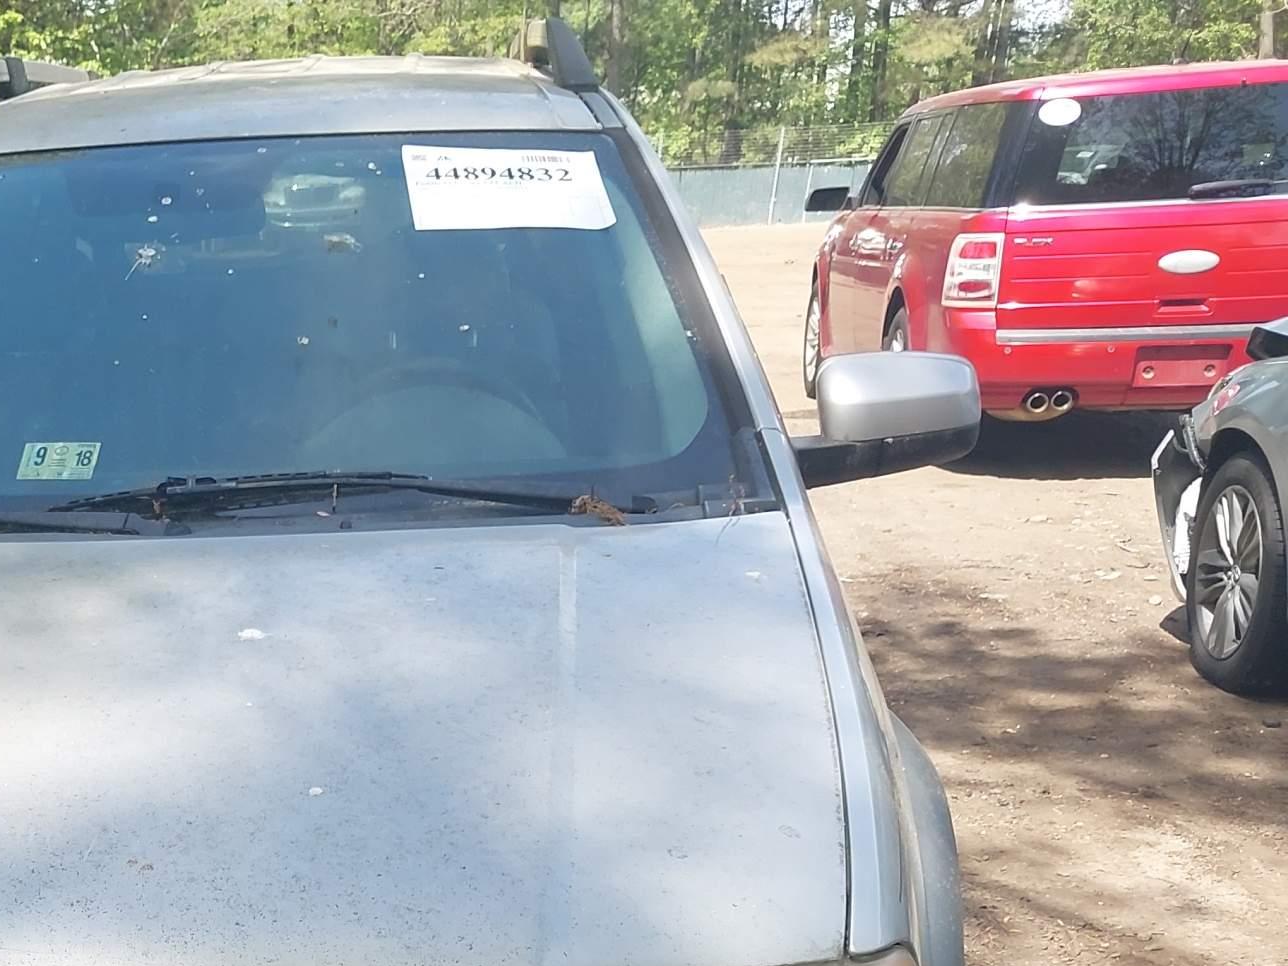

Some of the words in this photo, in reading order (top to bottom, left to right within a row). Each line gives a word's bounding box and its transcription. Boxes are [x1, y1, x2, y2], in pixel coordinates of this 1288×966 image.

[426, 167, 573, 182] 44894832
[33, 446, 49, 467] 9
[75, 450, 93, 467] 18
